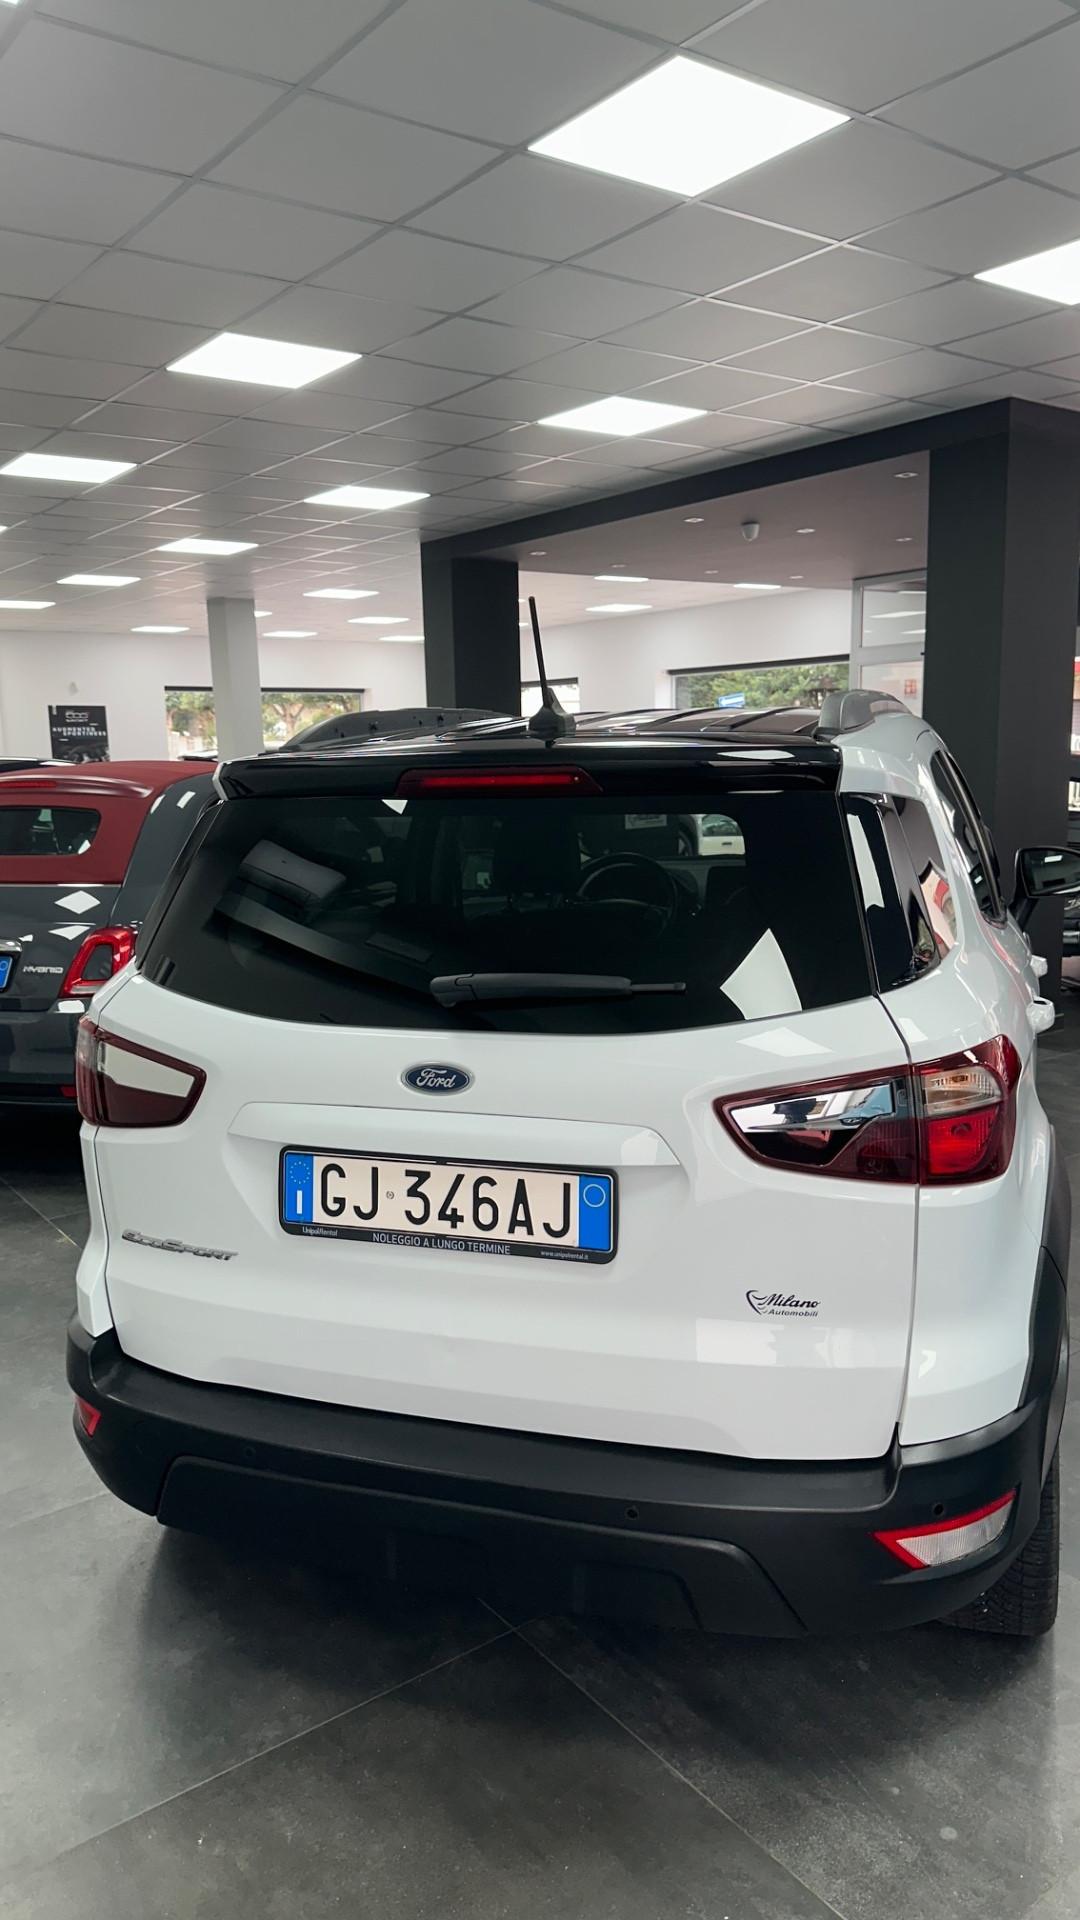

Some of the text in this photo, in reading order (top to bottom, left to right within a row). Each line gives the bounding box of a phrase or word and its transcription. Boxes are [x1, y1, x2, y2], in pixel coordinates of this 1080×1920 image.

[23, 965, 64, 974] HYBRID
[416, 1068, 457, 1088] Ford
[320, 1162, 572, 1239] GJ 346AJ
[372, 1232, 511, 1255] NOLEGGIO A LUNGO TERMINE
[758, 1293, 821, 1309] Milano
[767, 1308, 818, 1318] Automobili
